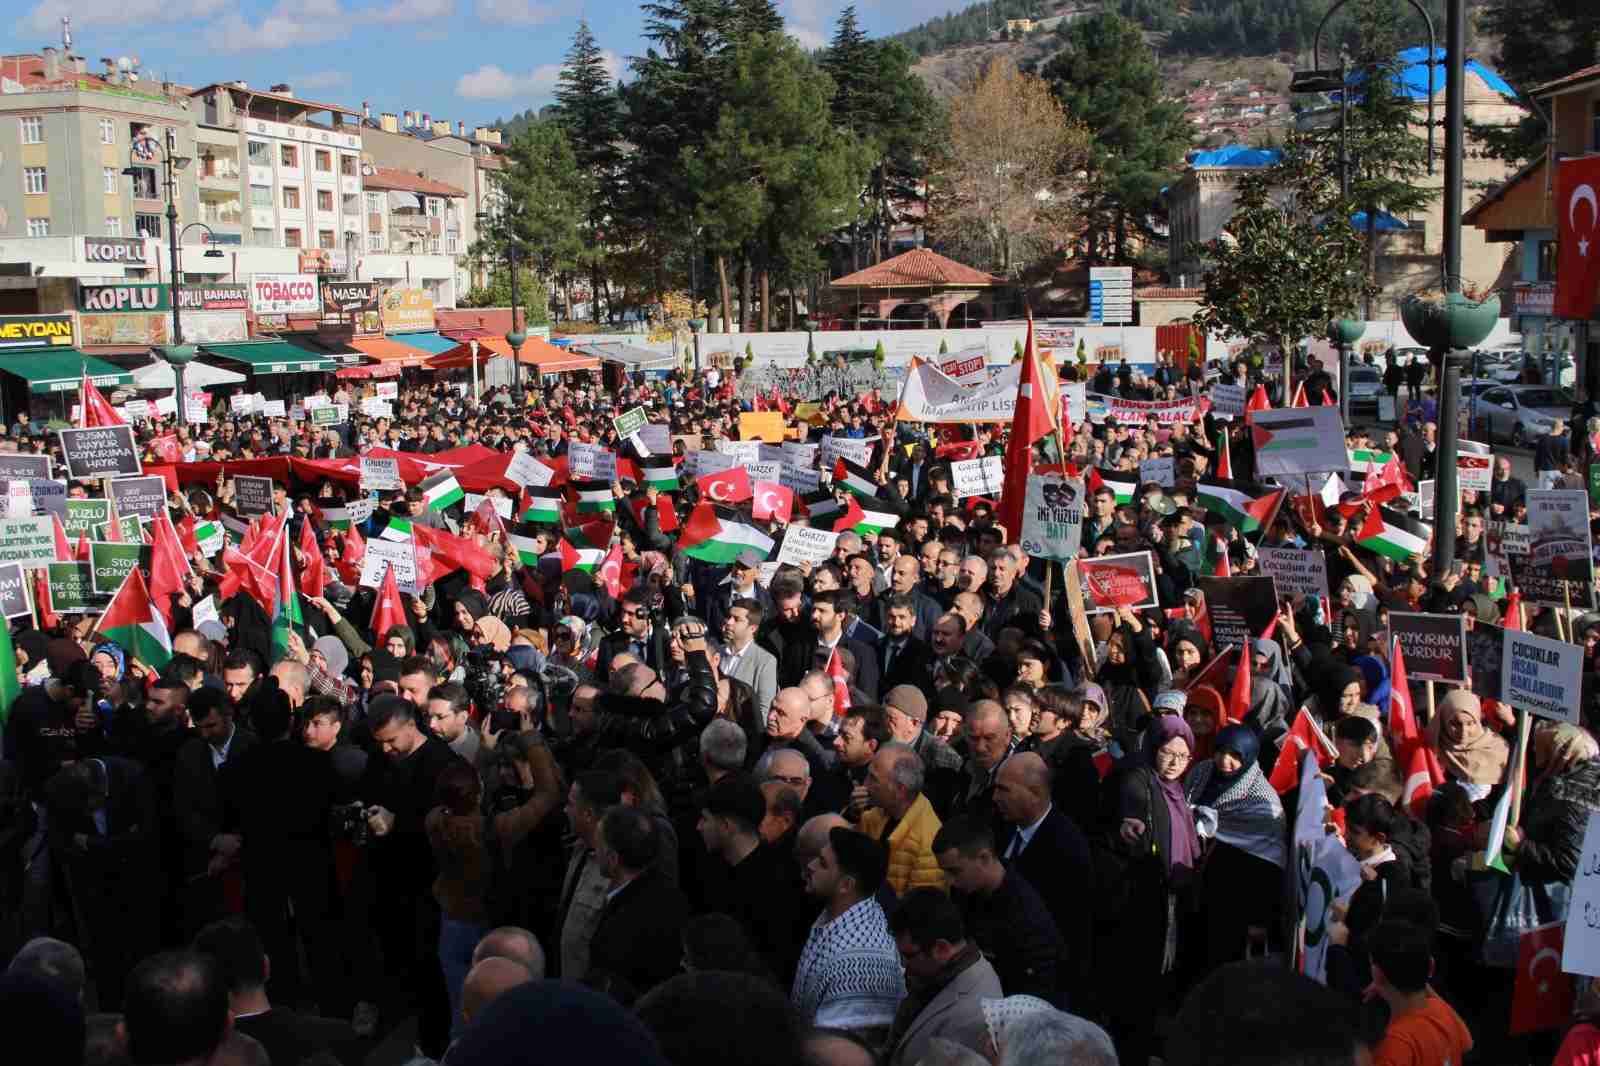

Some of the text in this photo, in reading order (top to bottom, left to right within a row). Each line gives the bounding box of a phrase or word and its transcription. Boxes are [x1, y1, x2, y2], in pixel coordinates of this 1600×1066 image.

[85, 244, 146, 261] KOPLU
[86, 288, 158, 310] KOPLU
[256, 282, 314, 300] TOBACCO
[333, 288, 370, 300] MASAL
[75, 430, 116, 440] SUSMA
